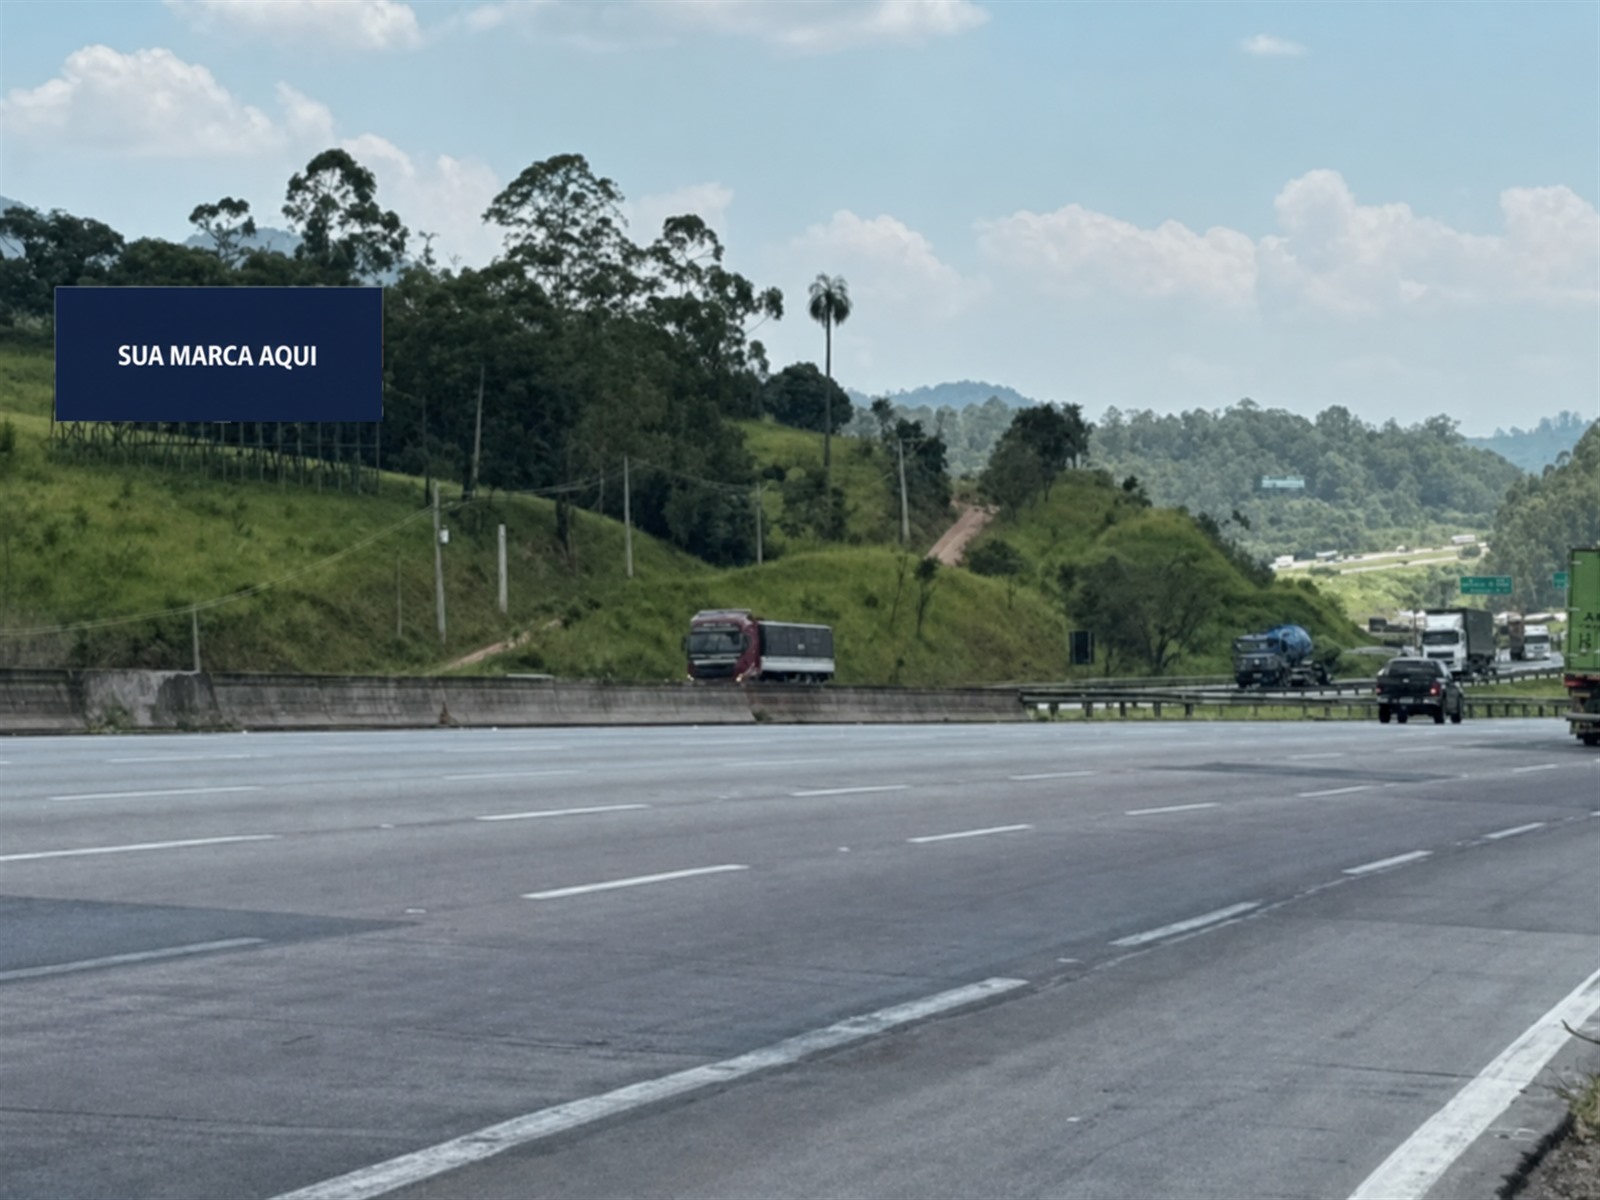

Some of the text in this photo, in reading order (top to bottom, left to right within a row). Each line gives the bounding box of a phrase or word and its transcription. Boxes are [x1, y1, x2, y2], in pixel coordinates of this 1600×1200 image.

[117, 344, 317, 370] SUA MARCA AQUI
